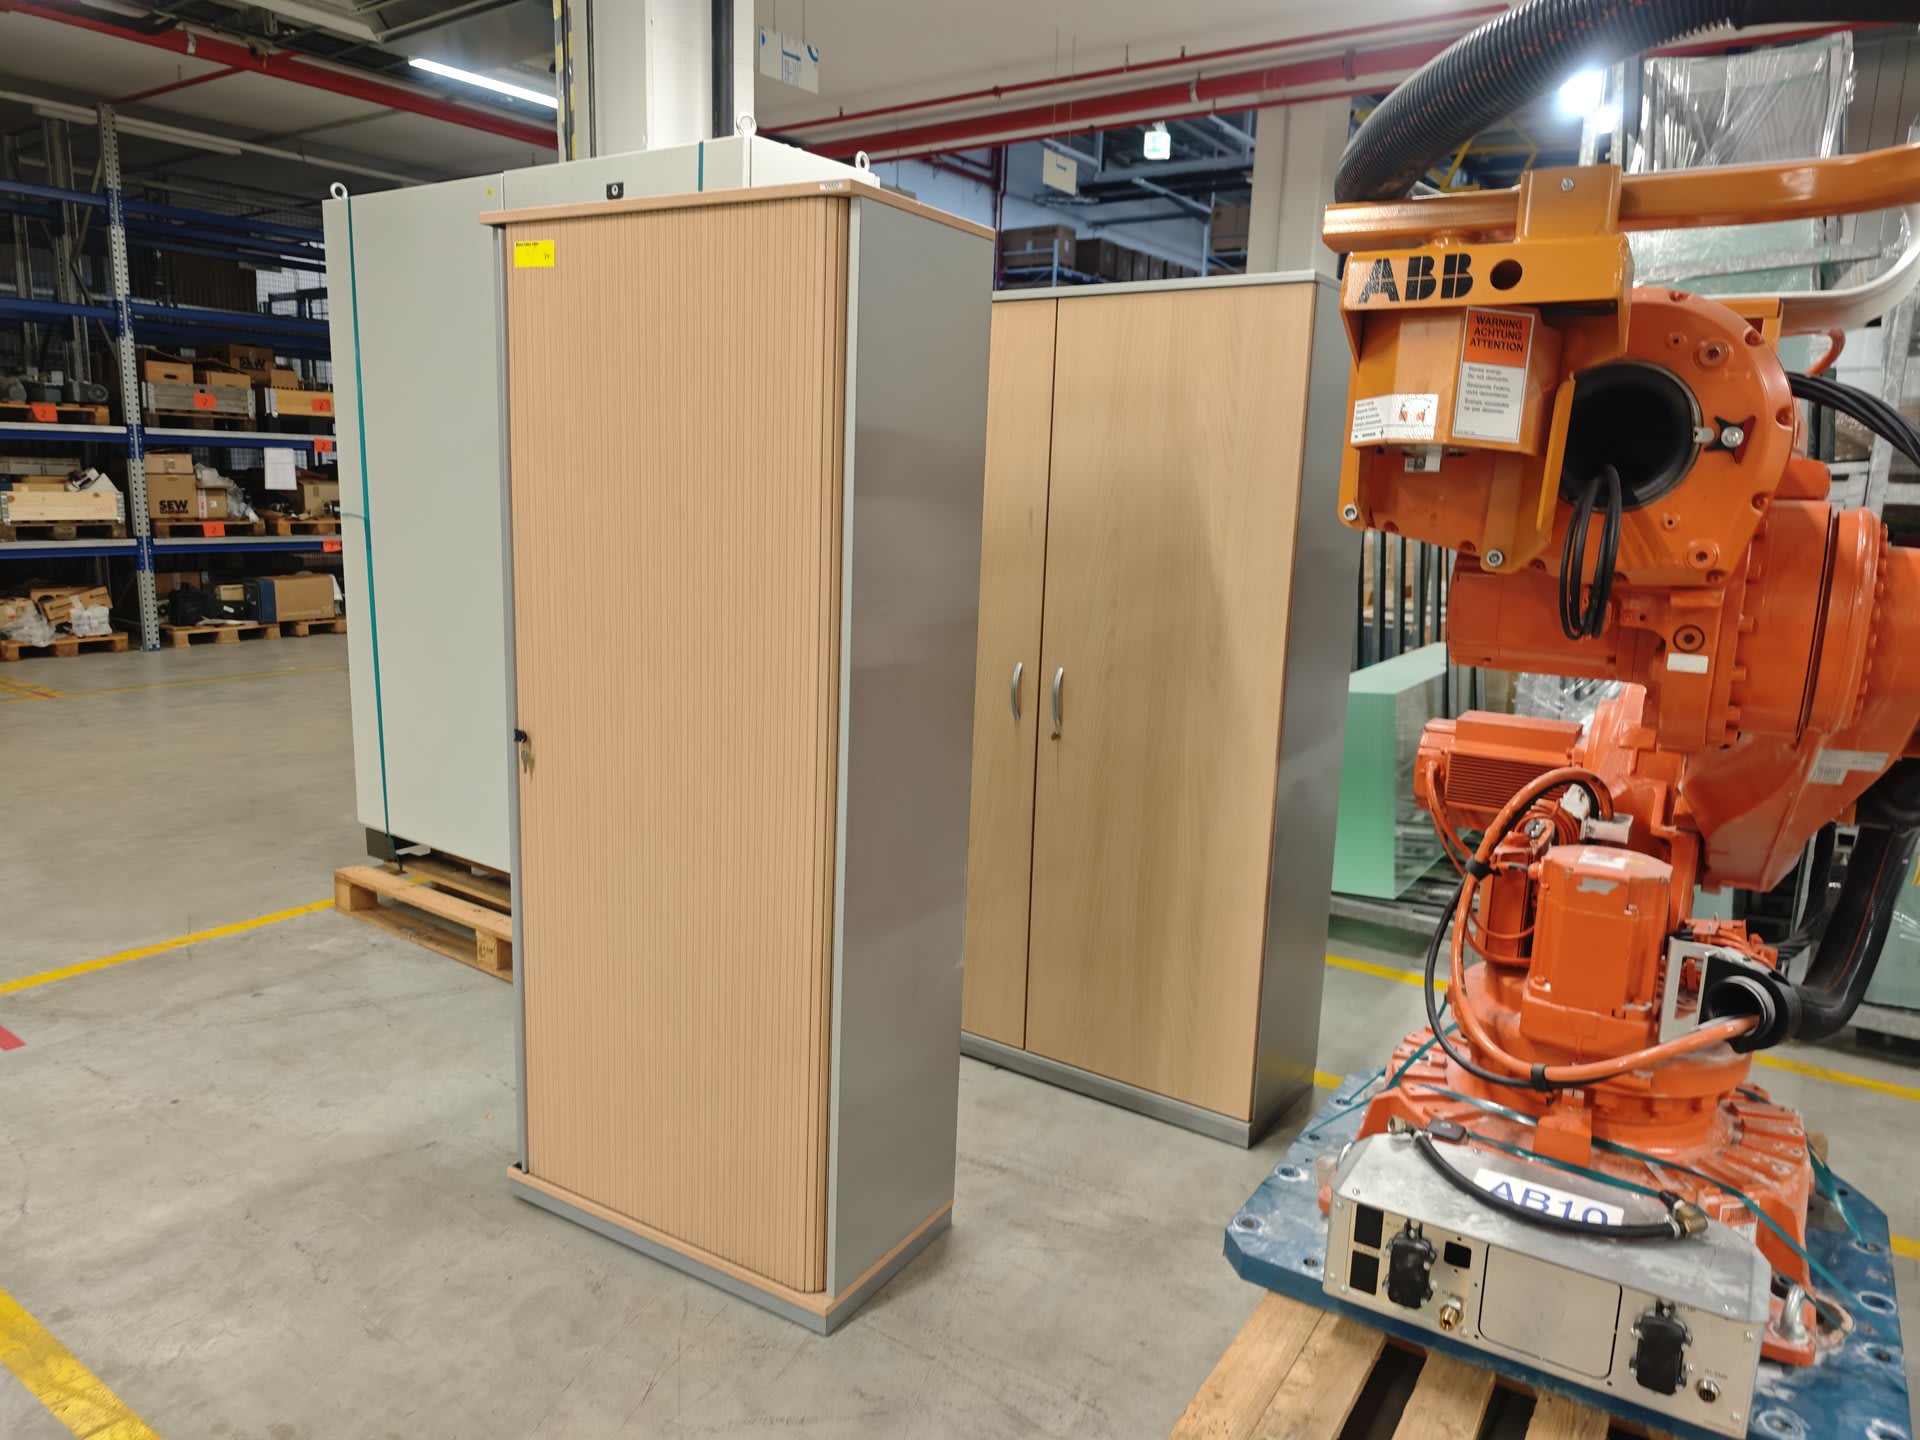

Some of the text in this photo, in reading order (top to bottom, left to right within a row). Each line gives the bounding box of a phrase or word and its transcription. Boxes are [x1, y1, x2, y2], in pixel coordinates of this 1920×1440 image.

[1358, 253, 1473, 304] ABB
[1476, 315, 1523, 330] WARNING
[1474, 327, 1522, 341] ACHTUNG
[1469, 338, 1524, 353] ATTENTION
[159, 499, 188, 510] SEW
[1489, 1180, 1609, 1226] AB10
